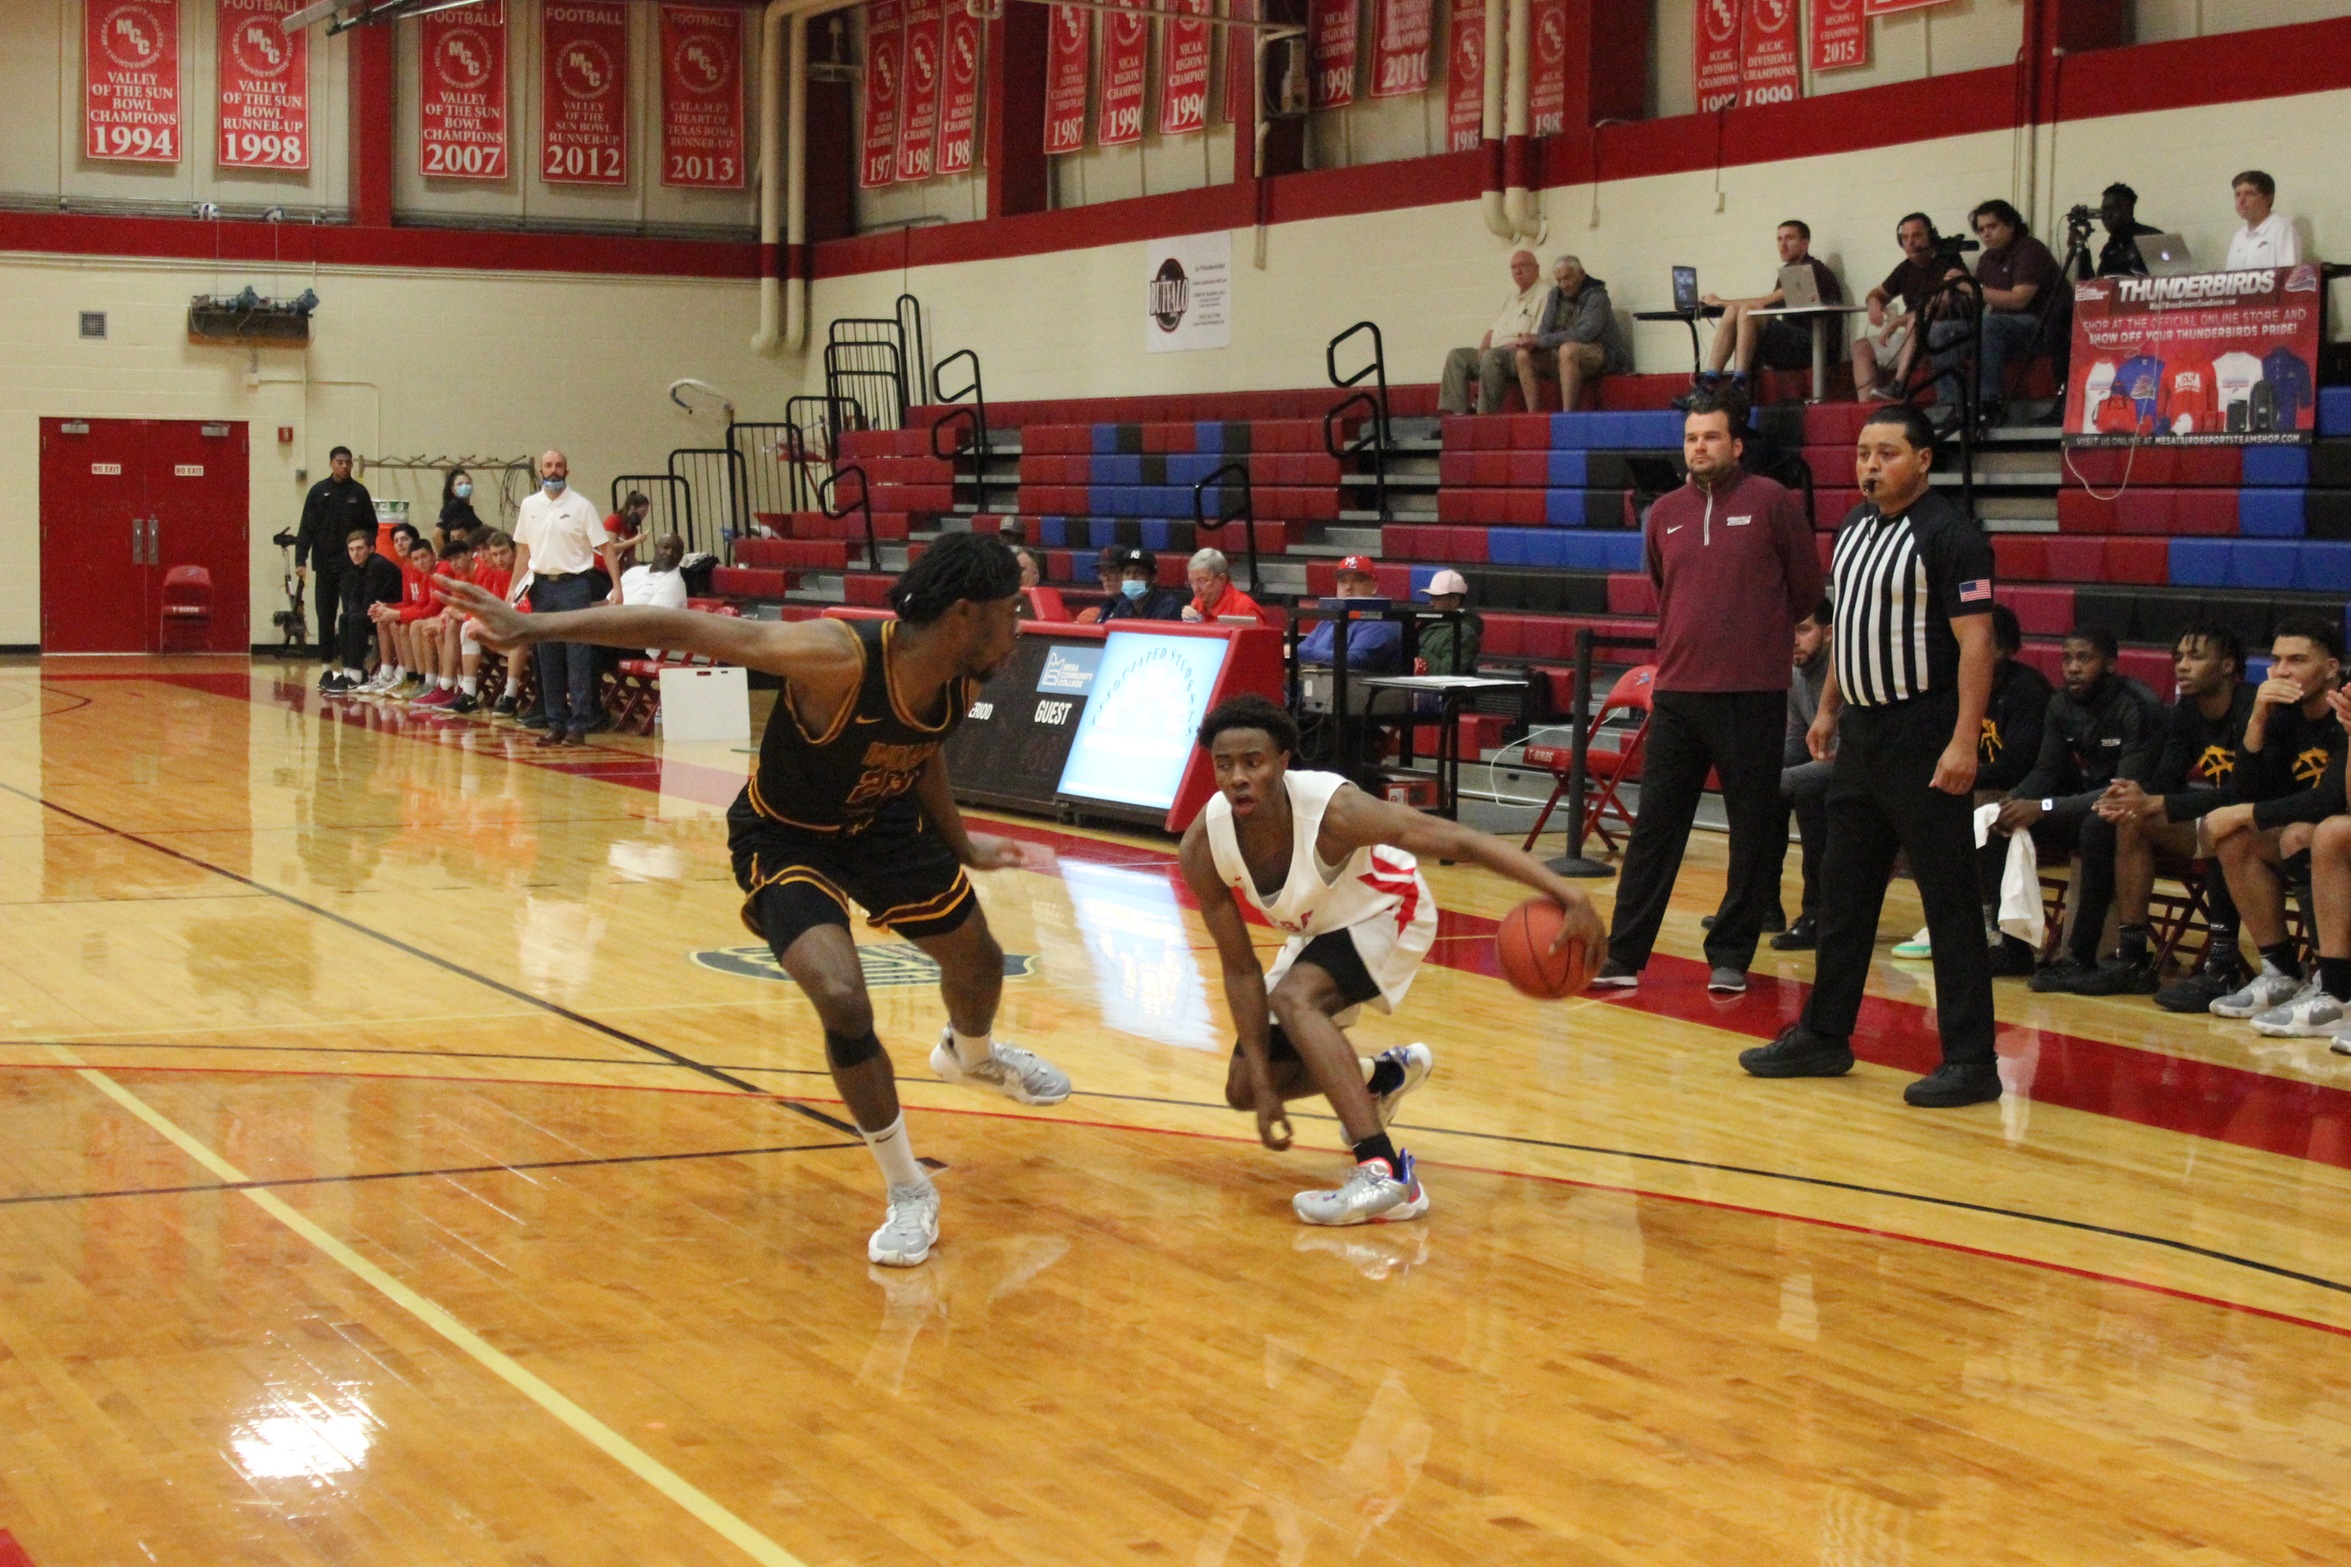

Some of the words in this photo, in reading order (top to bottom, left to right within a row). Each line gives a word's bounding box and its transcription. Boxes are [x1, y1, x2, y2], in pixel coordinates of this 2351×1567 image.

[546, 7, 623, 25] FOOTBALL
[671, 13, 732, 27] FOOTBALL
[116, 19, 151, 55] MCC
[1820, 27, 1859, 41] CHAMPIONS
[247, 28, 280, 65] MCC
[1823, 40, 1856, 64] 2015
[449, 41, 480, 76] MCC
[1748, 54, 1787, 69] DIVISION
[107, 71, 159, 86] VALLEY
[1743, 65, 1796, 82] CHAMPIONS
[91, 84, 111, 96] OF
[114, 85, 143, 97] THE
[145, 87, 174, 99] SUN
[238, 80, 288, 94] VALLEY
[113, 98, 154, 112] BOWL
[223, 92, 242, 104] OF
[245, 93, 272, 106] THE
[274, 95, 302, 107] SUN
[440, 91, 487, 105] VALLEY
[243, 106, 283, 120] BOWL
[425, 104, 443, 115] OF
[446, 105, 473, 117] THE
[475, 106, 500, 119] SUN
[563, 101, 604, 112] VALLEY
[90, 110, 177, 125] CHAMPIONS
[444, 117, 483, 130] BOWL
[565, 111, 580, 121] OF
[583, 112, 604, 122] THE
[674, 113, 711, 125] HEART
[714, 114, 729, 126] OF
[223, 118, 303, 133] RUNNER-UP
[556, 121, 577, 131] SUN
[580, 122, 612, 134] BOWL
[668, 125, 701, 136] TEXAS
[704, 126, 736, 138] BOWL
[94, 125, 174, 156] 1994
[424, 128, 503, 144] CHAMPIONS
[549, 132, 619, 146] RUNNER-UP
[670, 137, 734, 149] RUNNER-UP
[225, 133, 302, 164] 1998
[946, 139, 970, 167] 198
[426, 144, 500, 173] 2007
[546, 145, 621, 177] 2012
[906, 147, 929, 175] 198
[671, 155, 734, 181] 2013
[870, 155, 891, 181] 197
[2118, 271, 2275, 302] THUNDERBIRDS
[2082, 319, 2109, 331] SHOP
[2112, 319, 2123, 330] AT
[2127, 318, 2147, 329] THE
[2151, 315, 2196, 328] OFFICIAL
[2201, 312, 2239, 325] ONLINE
[2242, 310, 2279, 322] STORE
[2284, 308, 2306, 320] AND
[2089, 332, 2118, 345] SHOW
[2120, 331, 2142, 342] OFF
[2146, 330, 2173, 341] YOUR
[2176, 326, 2258, 340] THUNDERBIRDS
[2262, 323, 2297, 336] PRIDE!
[2076, 437, 2098, 446] VISIT
[2101, 437, 2110, 446] US
[2110, 436, 2141, 446] ONLINE
[2143, 436, 2152, 445] AT
[2154, 434, 2299, 445] MESATBIRDSSPORTSTEAMSHOP.COM
[1063, 664, 1080, 672] MESA
[1057, 679, 1084, 688] COLLEGE
[1060, 671, 1094, 681] COMMUNITY
[1092, 647, 1167, 726] ASSOCIATED
[1170, 649, 1196, 737] STUDENTS
[968, 702, 993, 720] ERIOD
[1034, 700, 1073, 725] GUEST
[1528, 749, 1554, 763] T-BIRDS
